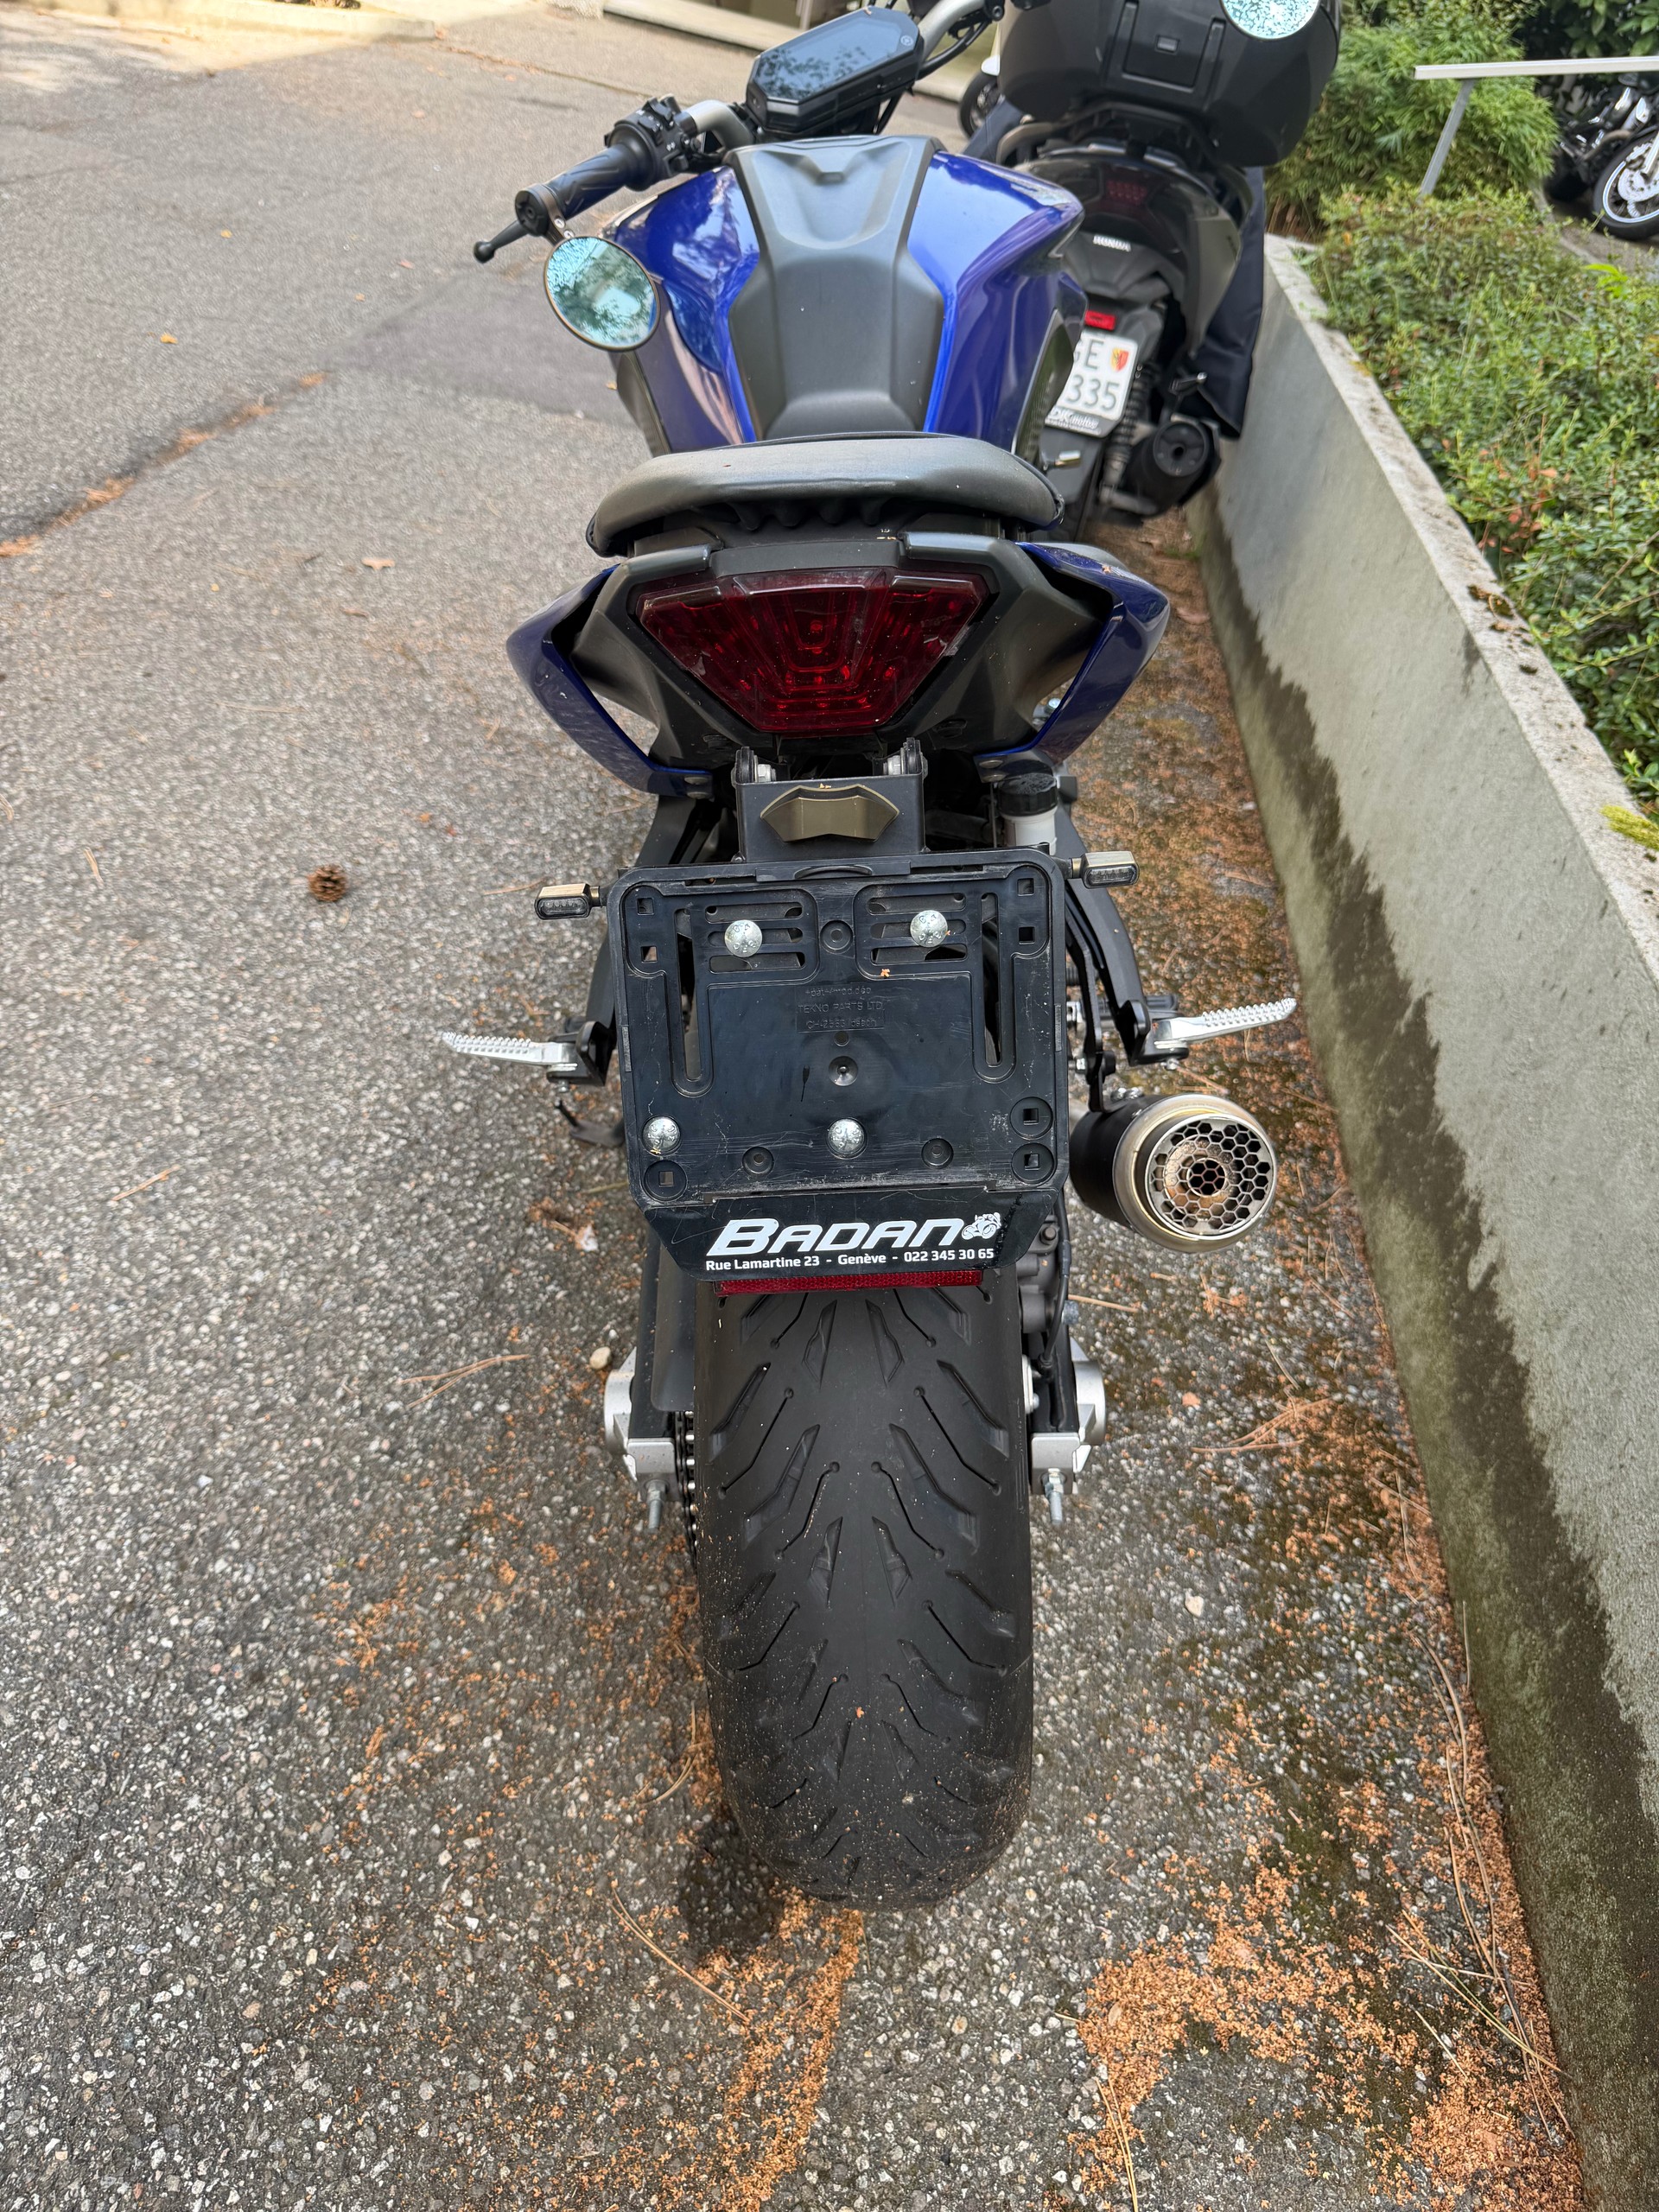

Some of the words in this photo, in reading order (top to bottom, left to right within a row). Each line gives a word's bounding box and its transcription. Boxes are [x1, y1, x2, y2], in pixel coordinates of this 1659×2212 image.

[1065, 374, 1119, 411] 335
[798, 1003, 830, 1014] TEKNO
[833, 1001, 863, 1012] PARTS
[705, 1217, 965, 1256] BADAN
[706, 1260, 732, 1271] Rue
[734, 1257, 801, 1269] Lamartine
[804, 1255, 820, 1267] 23
[837, 1254, 887, 1265] Genève
[904, 1251, 928, 1262] 022
[931, 1249, 956, 1262] 345
[958, 1249, 976, 1260] 30
[978, 1248, 995, 1259] 65
